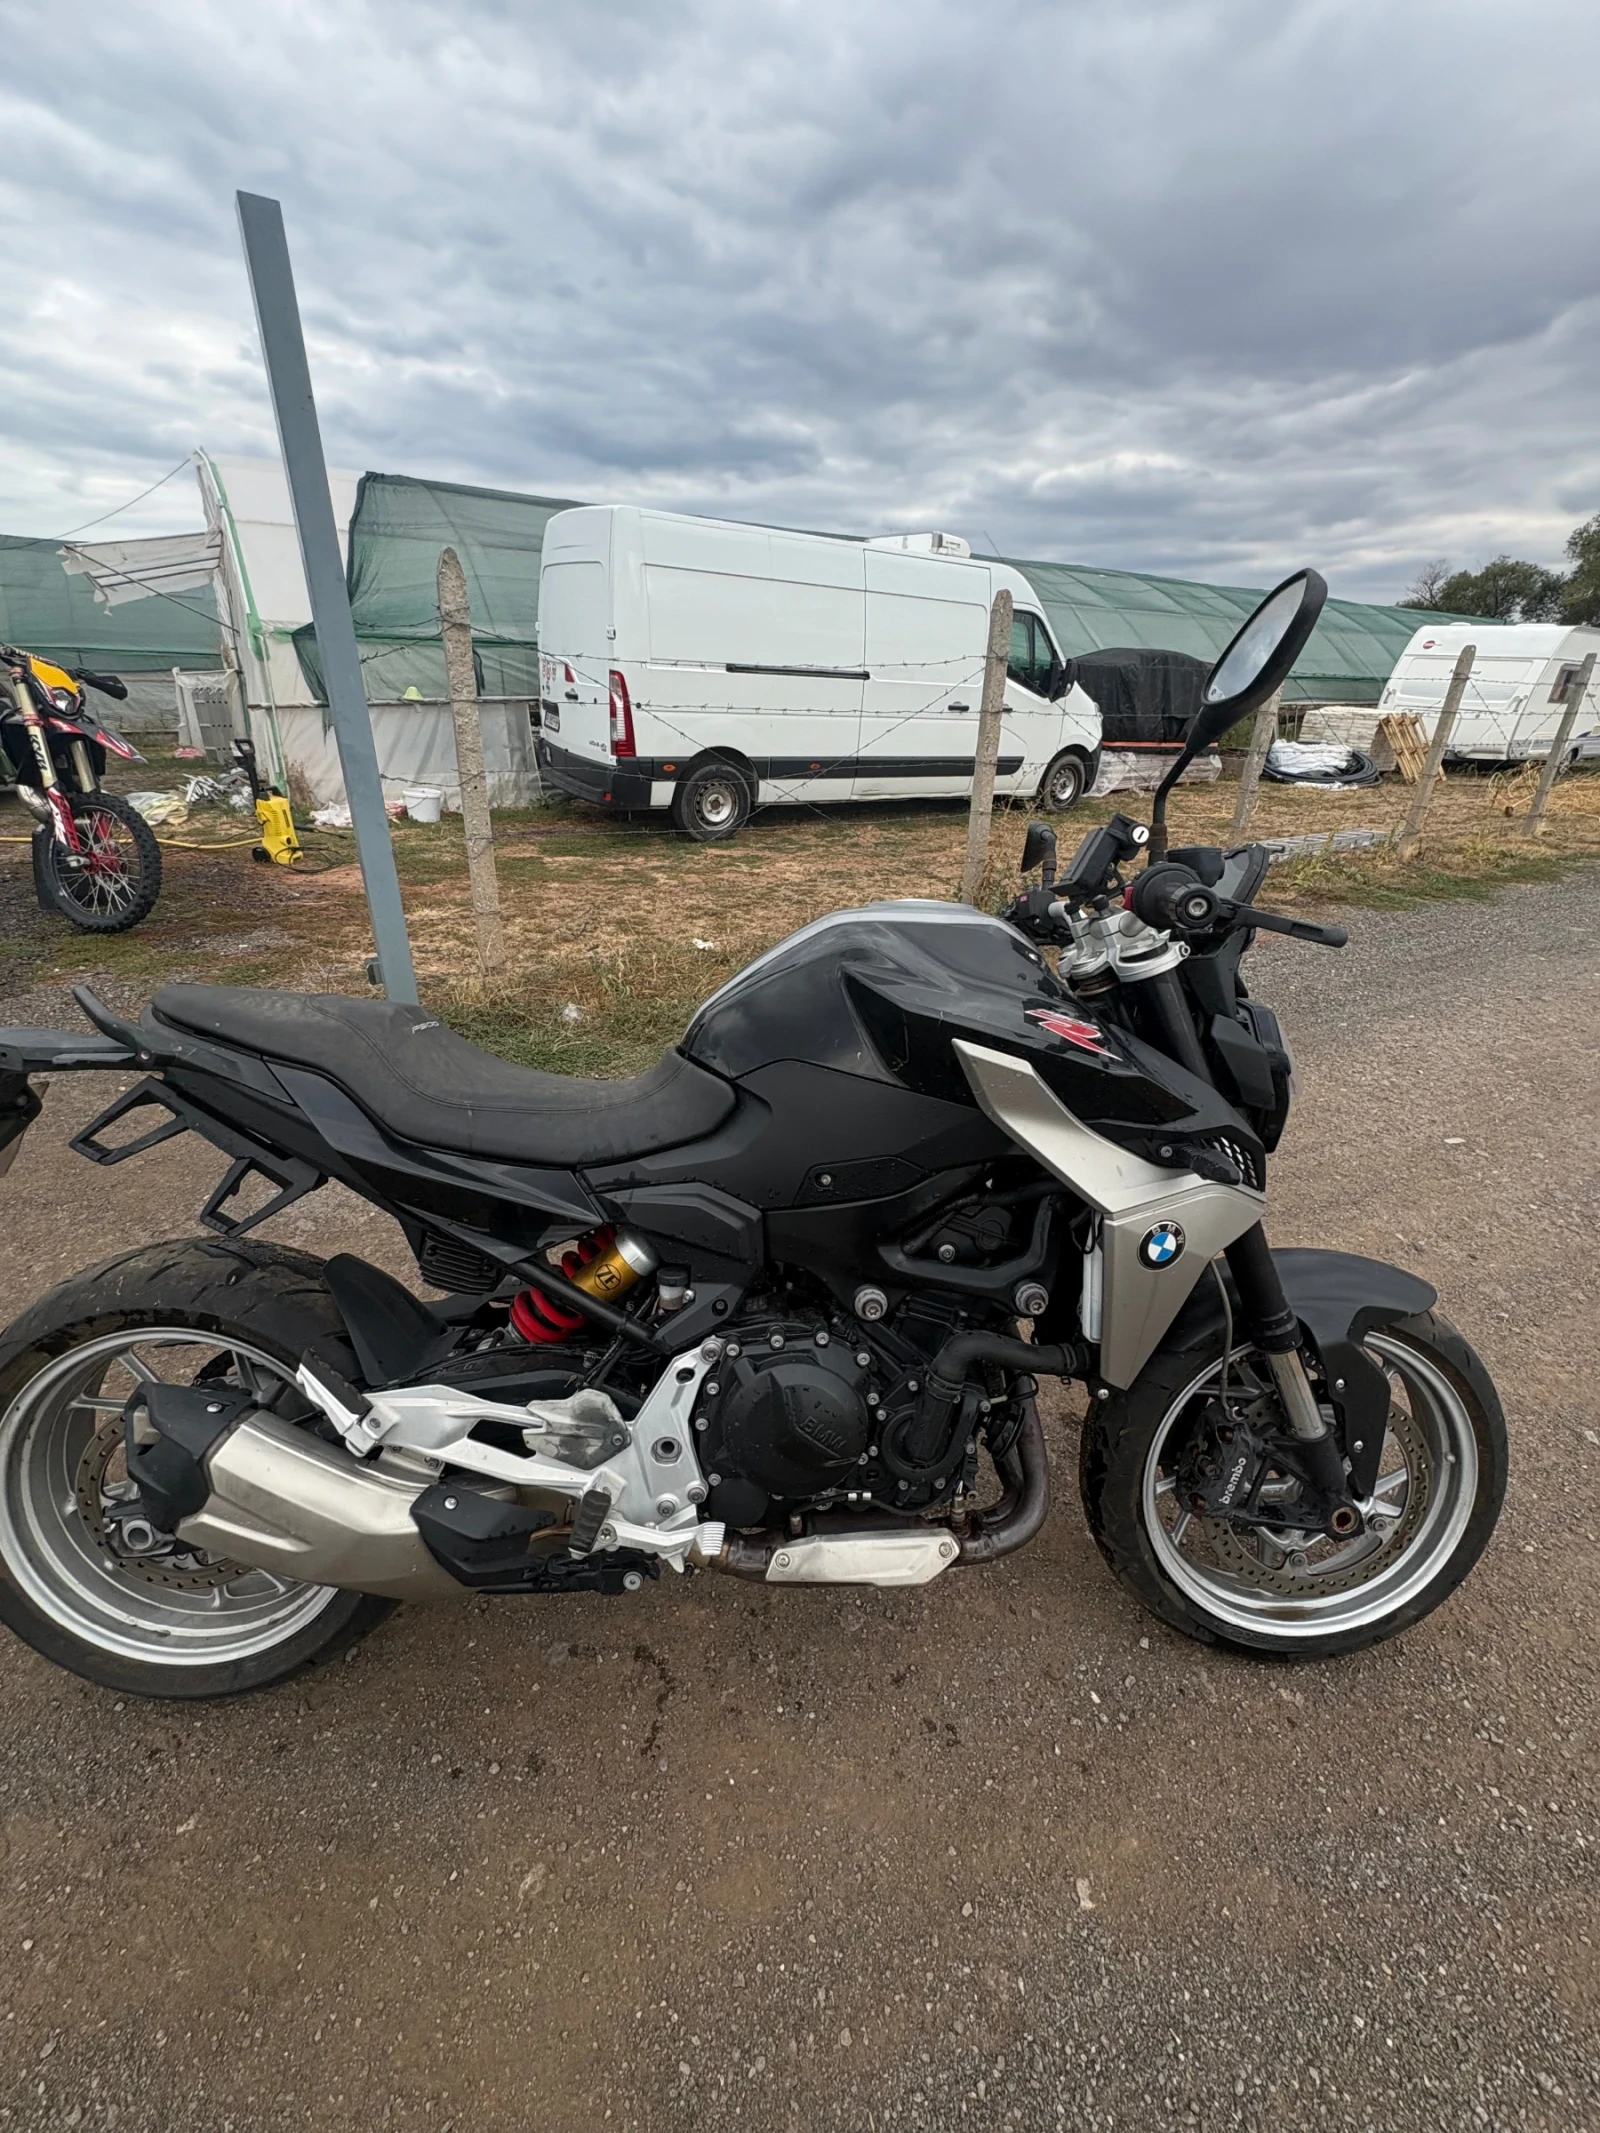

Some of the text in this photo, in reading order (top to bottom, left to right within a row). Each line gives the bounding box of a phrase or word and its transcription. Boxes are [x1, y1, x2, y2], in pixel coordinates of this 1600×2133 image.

[1151, 1224, 1185, 1245] BMW
[596, 1264, 621, 1291] ZF
[800, 1415, 848, 1449] BMW
[1218, 1457, 1247, 1505] brembo
